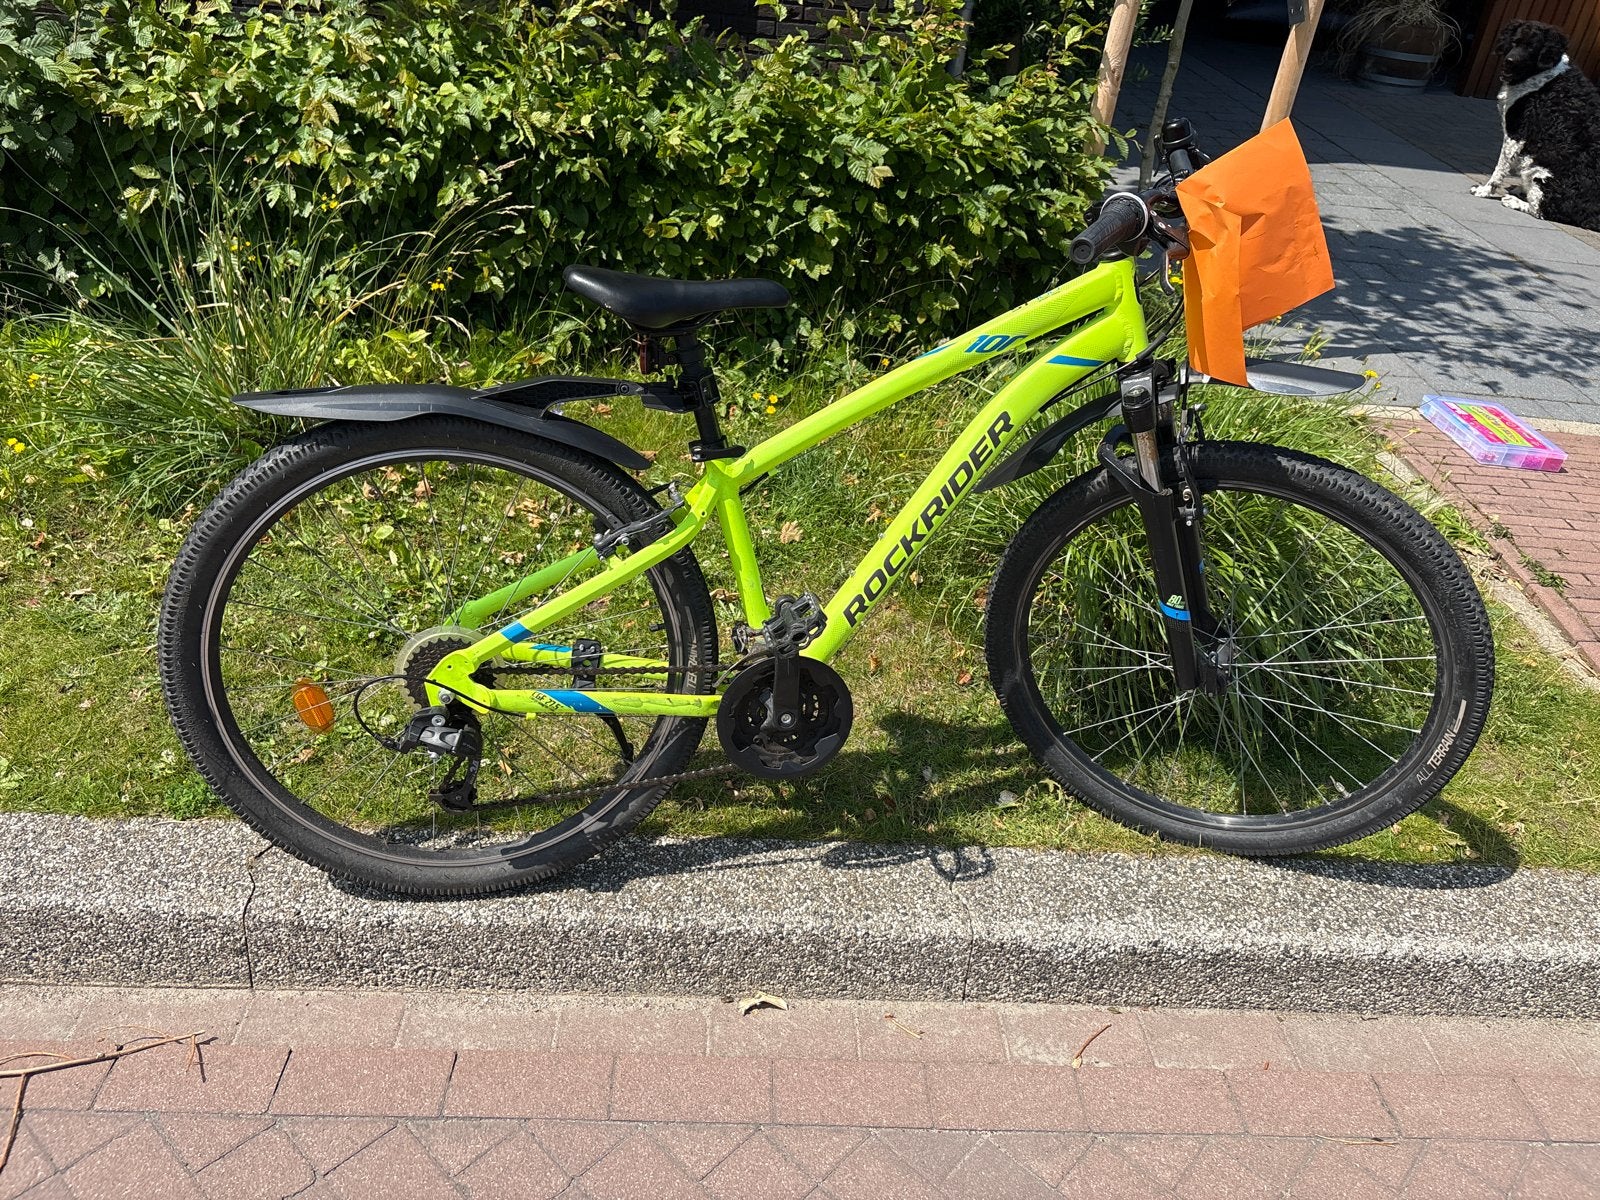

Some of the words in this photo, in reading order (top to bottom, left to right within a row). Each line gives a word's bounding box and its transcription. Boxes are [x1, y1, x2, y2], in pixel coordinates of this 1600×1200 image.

[843, 411, 1015, 627] ROCKRIDER
[1416, 767, 1433, 785] ALL
[1427, 729, 1456, 769] TERRAIN
